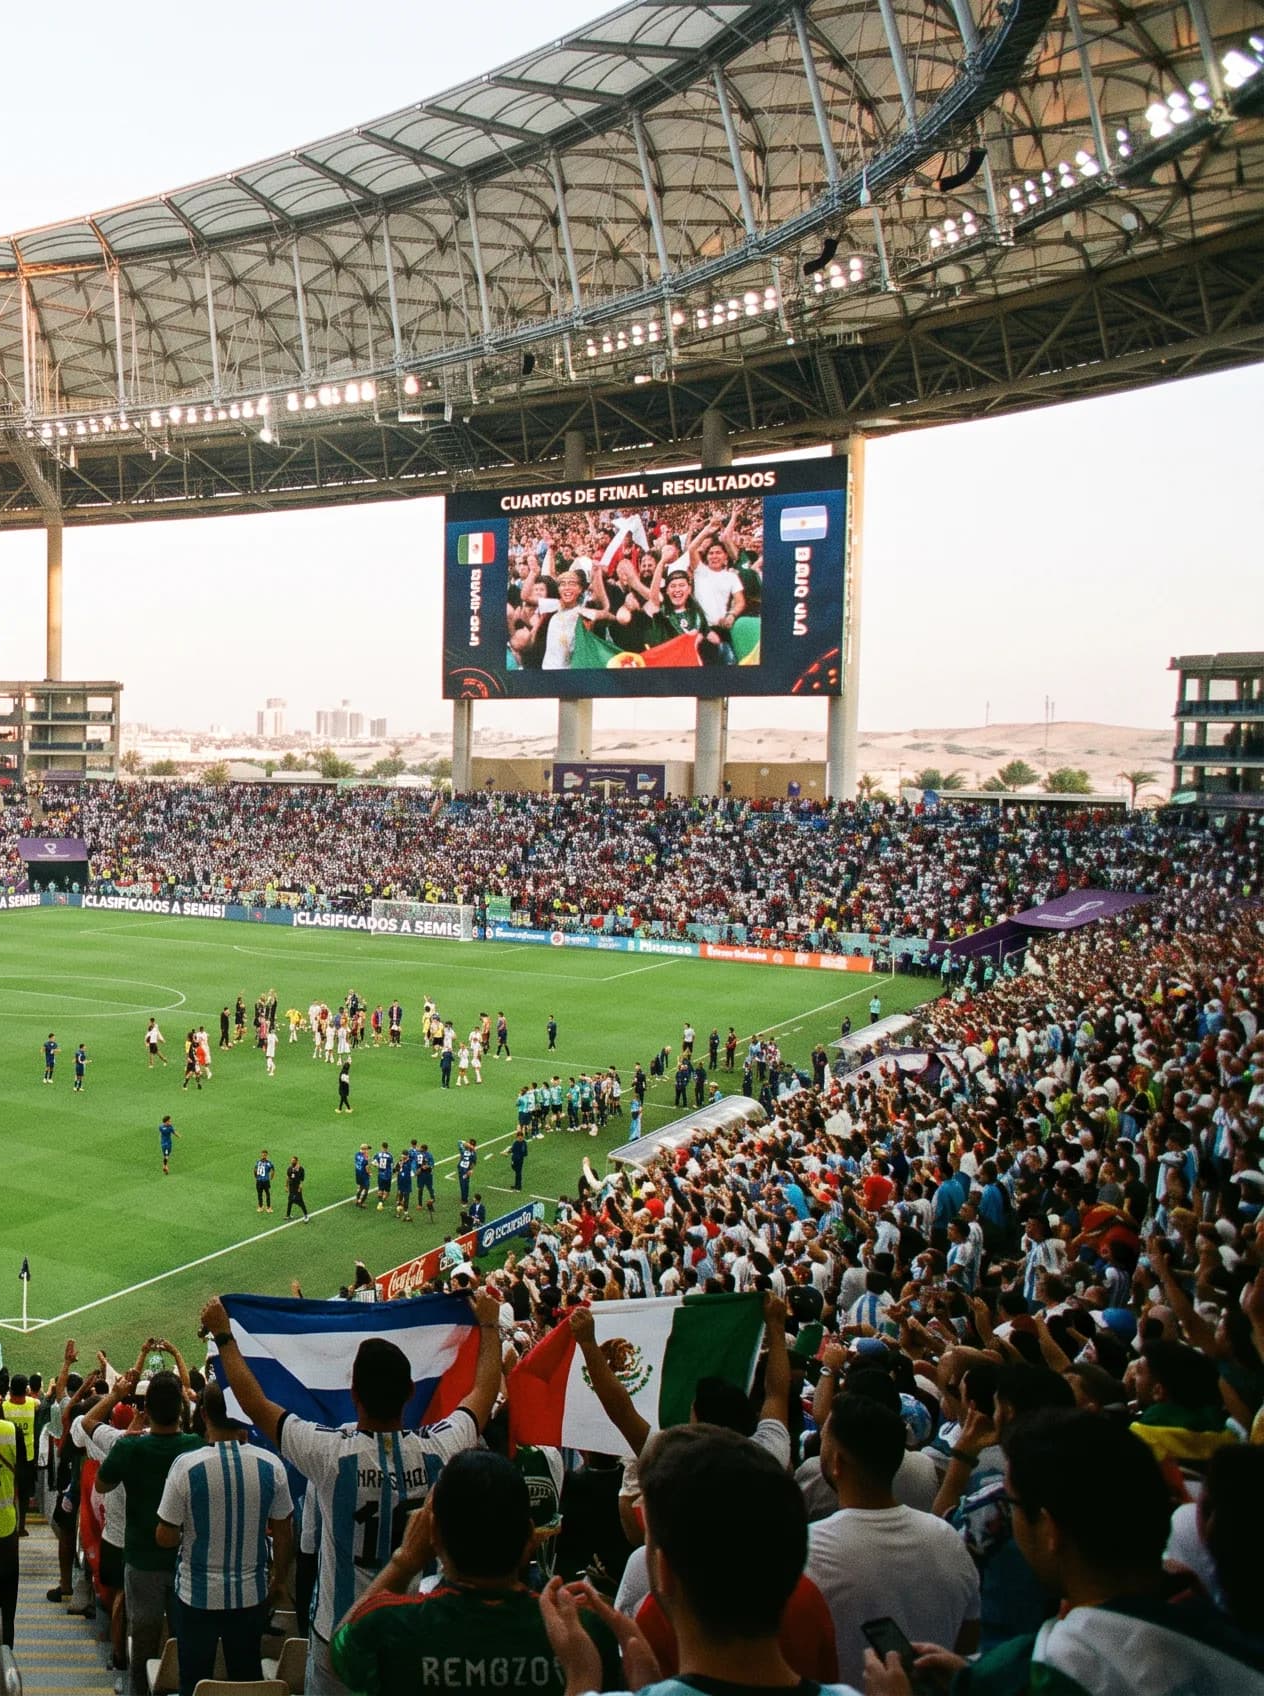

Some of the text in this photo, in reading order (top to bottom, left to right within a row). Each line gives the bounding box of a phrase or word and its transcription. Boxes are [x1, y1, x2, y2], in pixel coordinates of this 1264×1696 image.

[500, 492, 572, 511] CUARTOS
[575, 489, 596, 504] DE
[599, 484, 648, 502] FINAL
[662, 471, 776, 496] RESULTADOS
[0, 897, 7, 909] A
[171, 901, 181, 914] A
[183, 903, 226, 918] SEMIS!
[400, 921, 412, 933] A
